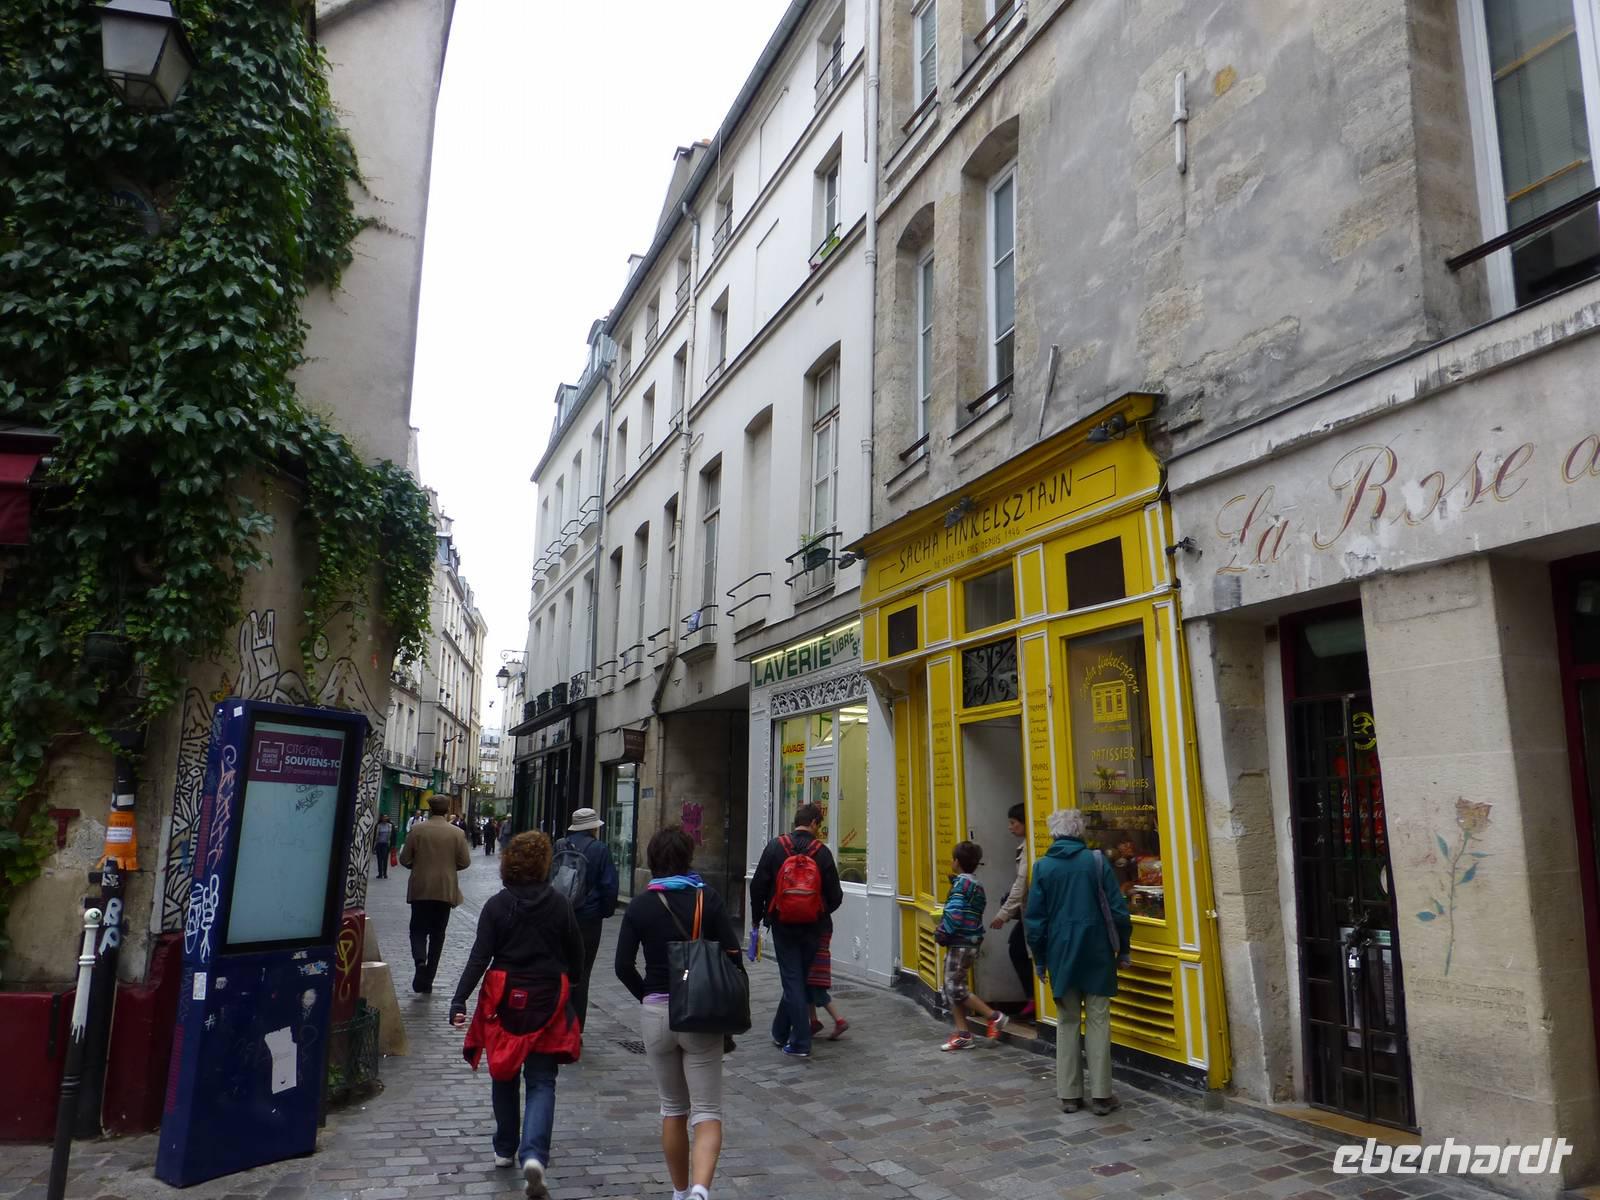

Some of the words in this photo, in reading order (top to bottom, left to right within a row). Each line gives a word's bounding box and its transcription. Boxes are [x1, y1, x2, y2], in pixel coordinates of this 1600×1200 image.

[899, 532, 939, 574] SACHA
[944, 467, 1074, 549] FINKELSZTAJN
[1312, 443, 1535, 550] Rose
[754, 636, 832, 688] LAVERIE
[782, 743, 805, 754] LAVAGE
